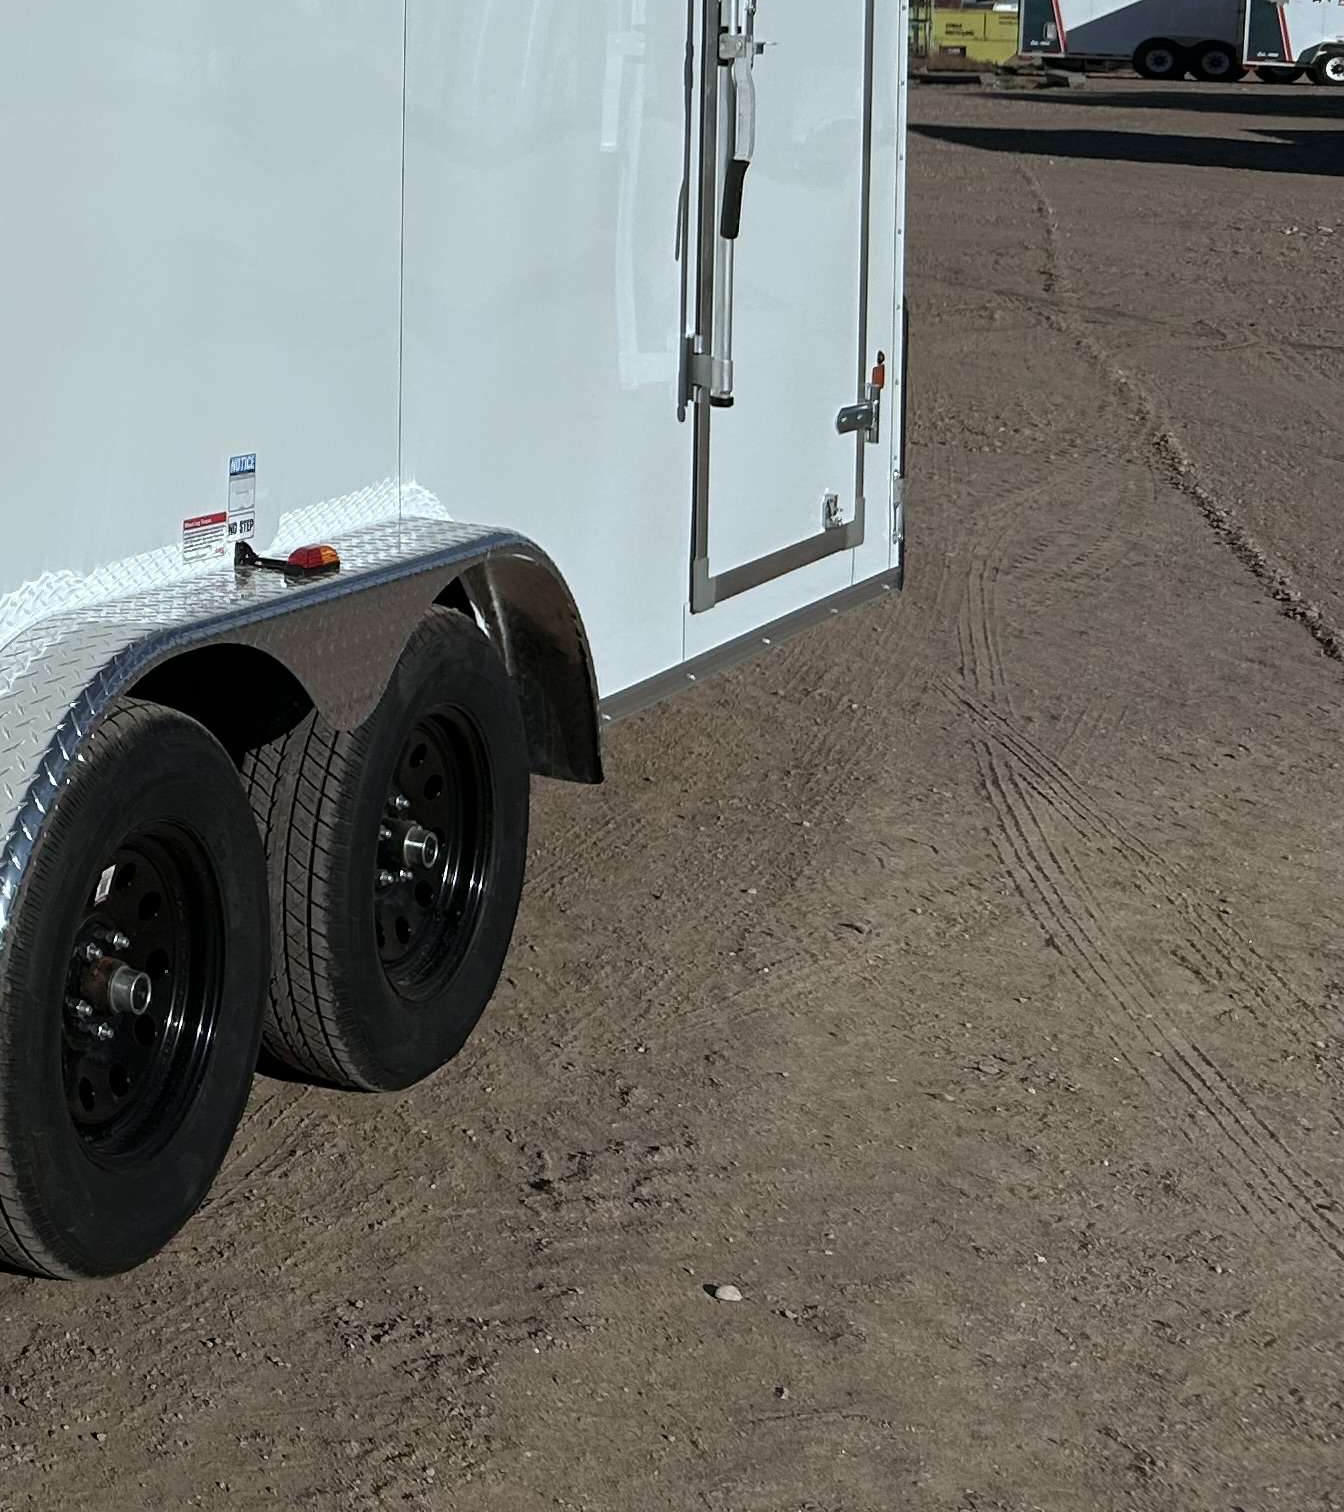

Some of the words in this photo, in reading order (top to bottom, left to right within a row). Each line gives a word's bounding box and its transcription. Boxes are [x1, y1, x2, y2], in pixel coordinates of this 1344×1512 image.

[230, 454, 256, 474] NOTICE
[228, 521, 238, 536] NO
[239, 518, 255, 534] STEP
